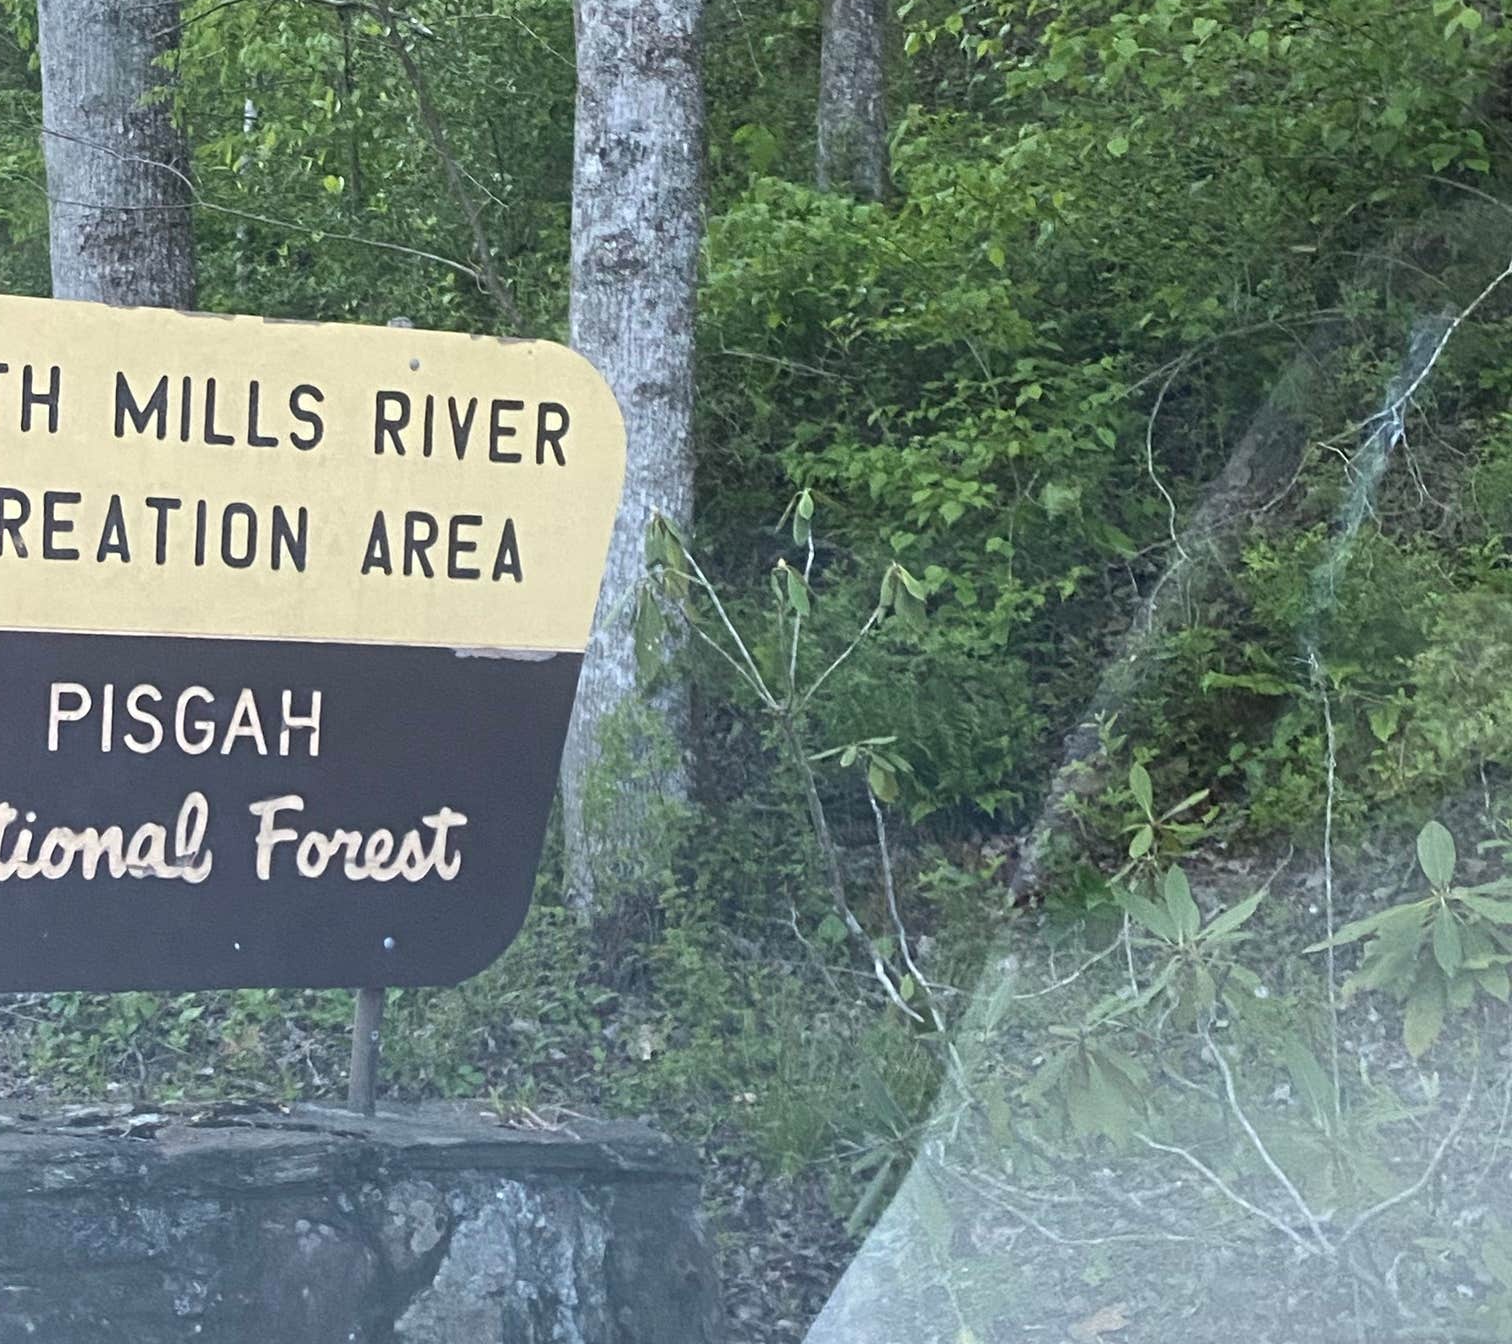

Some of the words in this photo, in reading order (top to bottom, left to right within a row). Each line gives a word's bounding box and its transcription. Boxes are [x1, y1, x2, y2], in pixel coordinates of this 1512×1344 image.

[114, 371, 325, 451] MILLS
[373, 391, 571, 467] RIVER
[360, 511, 523, 583] AREA
[48, 682, 322, 758] PISGAH
[248, 795, 468, 883] Forest
